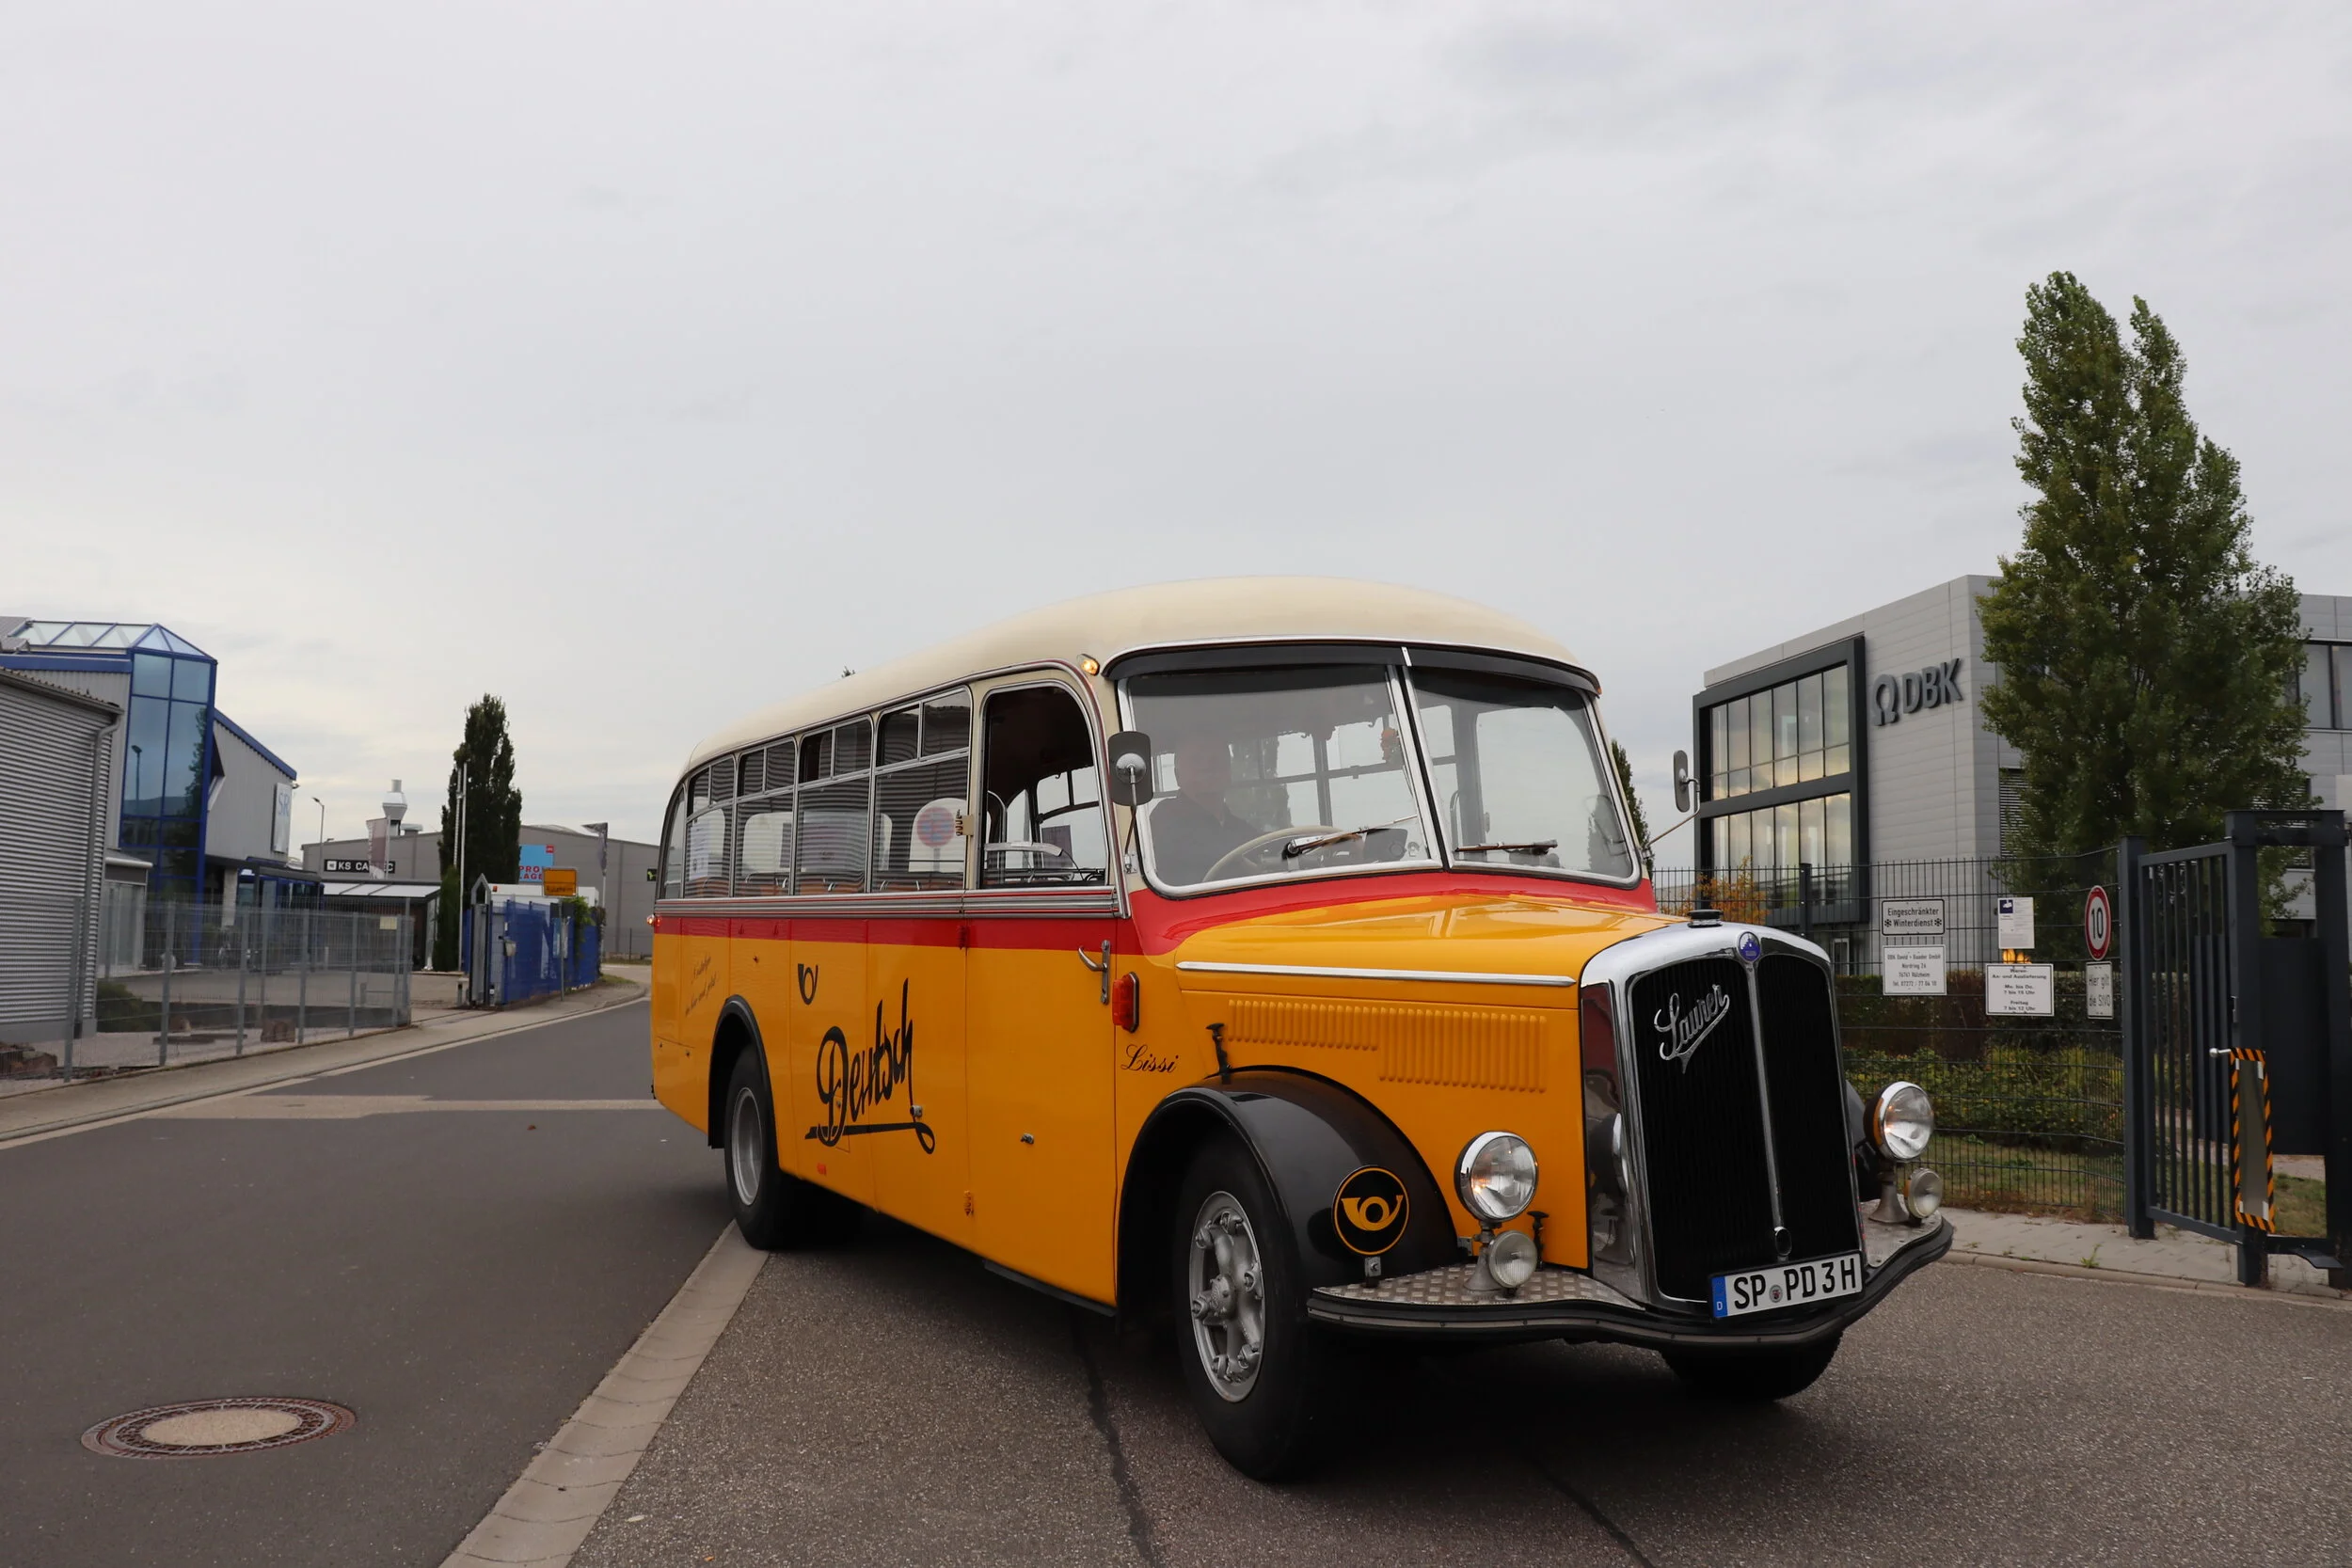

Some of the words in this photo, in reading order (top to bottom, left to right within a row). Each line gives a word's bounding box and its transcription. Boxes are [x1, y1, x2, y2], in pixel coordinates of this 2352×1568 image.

[1901, 657, 1963, 714] DBK
[338, 862, 351, 870] KS
[1887, 907, 1939, 918] Eingeschränkter
[1893, 919, 1933, 927] Winterdienst
[2091, 907, 2104, 939] 10
[1654, 984, 1730, 1073] Saurer
[806, 977, 935, 1154] Deutsch
[1120, 1044, 1179, 1073] Lissi
[1716, 1301, 1724, 1311] D
